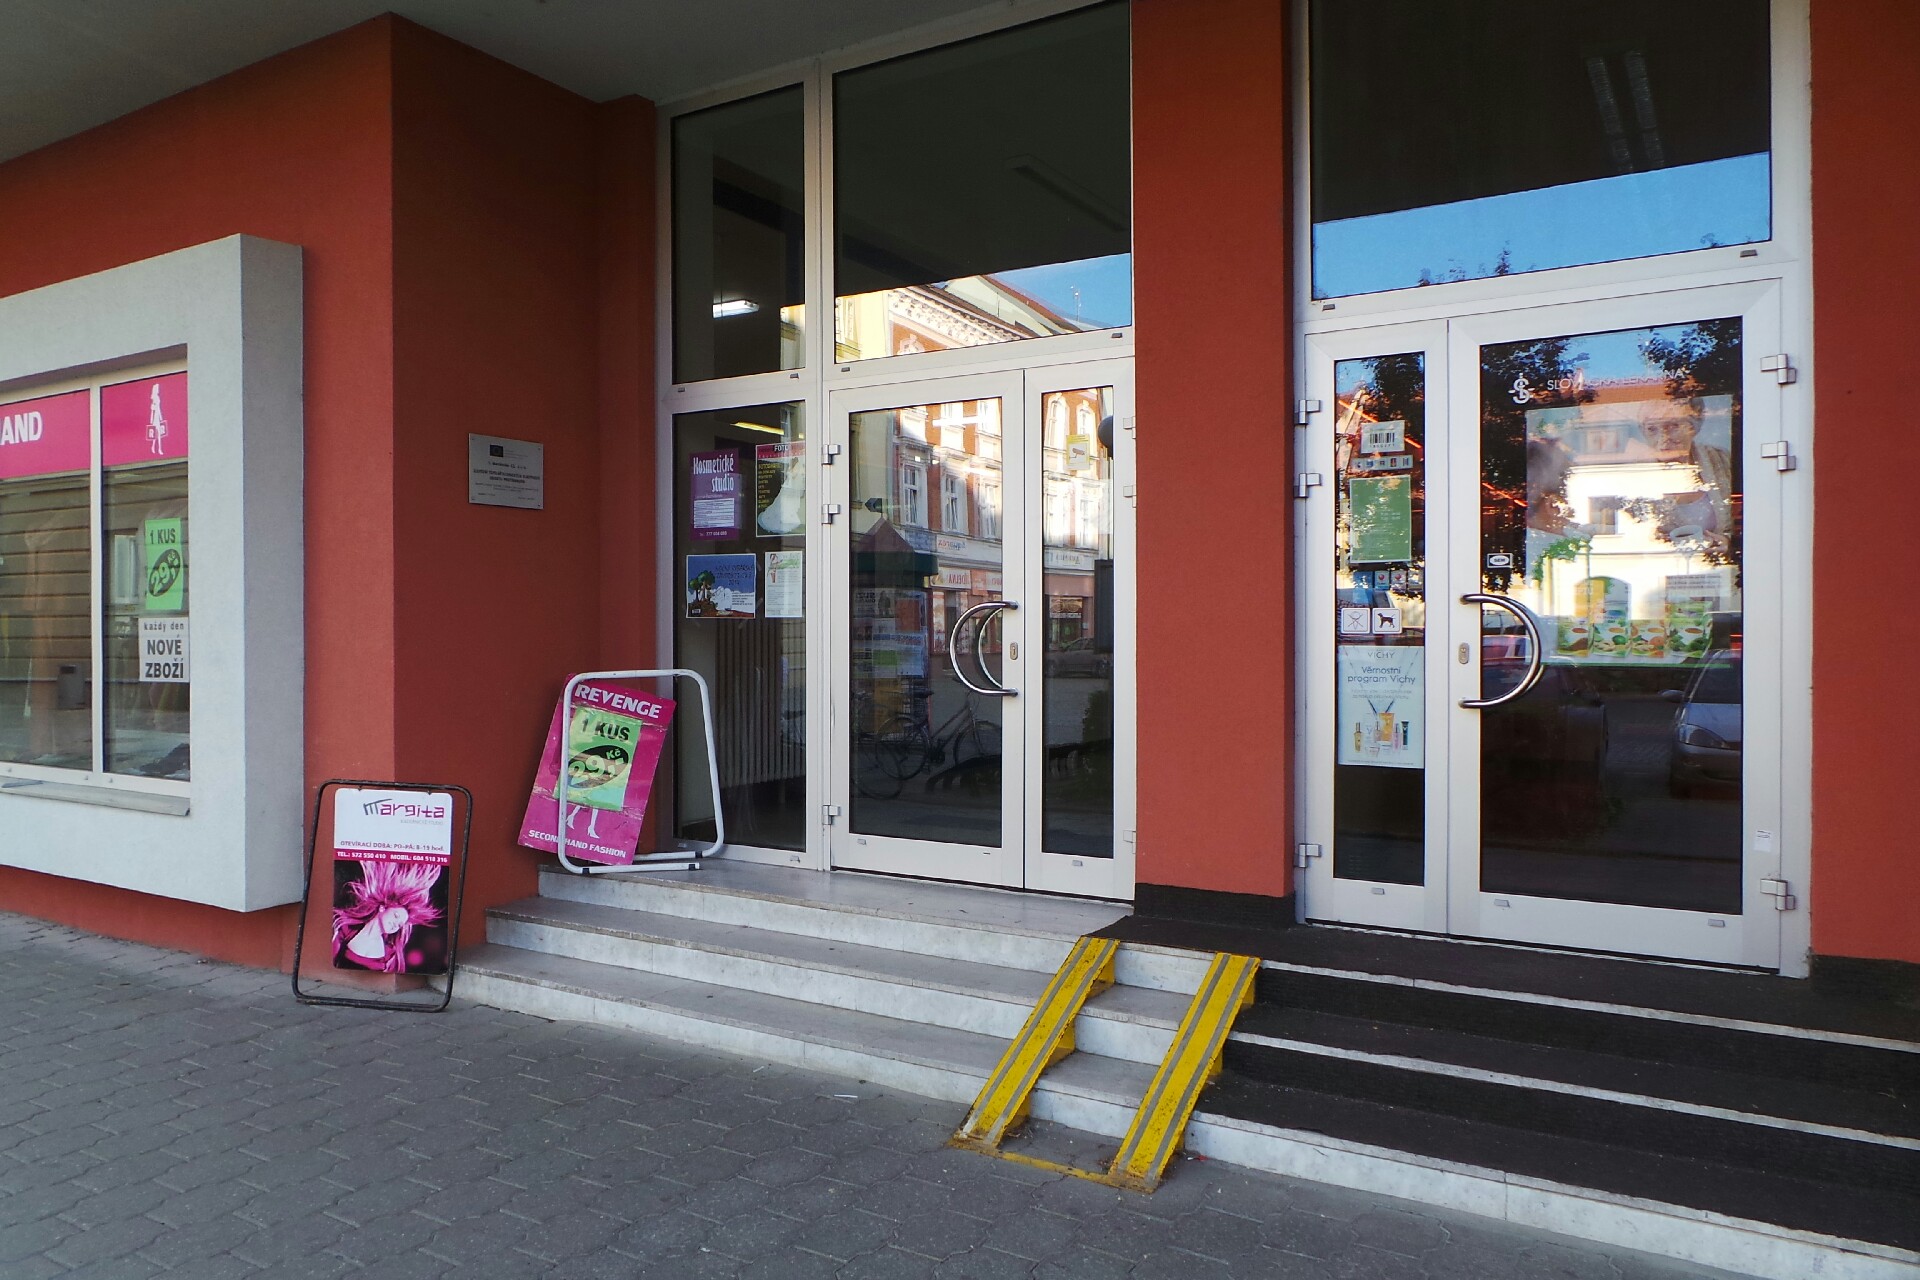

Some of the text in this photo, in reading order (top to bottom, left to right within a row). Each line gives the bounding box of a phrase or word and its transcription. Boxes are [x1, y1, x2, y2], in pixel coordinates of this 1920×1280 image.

[694, 454, 734, 475] Kosmetické
[712, 474, 735, 492] studio
[150, 528, 176, 545] 1 KUS
[171, 620, 184, 630] den
[147, 634, 182, 655] NOVÉ
[1368, 651, 1395, 659] VICHY
[145, 657, 183, 679] ZBOŽÍ
[1362, 666, 1400, 674] Věrnostní
[1347, 675, 1416, 685] program Vichy
[575, 684, 662, 719] REVENGE
[582, 719, 631, 742] 1 KUS
[606, 748, 622, 760] Kč
[340, 840, 371, 848] OTEVÍRACÍ
[528, 829, 627, 859] SECON HAND FASHION
